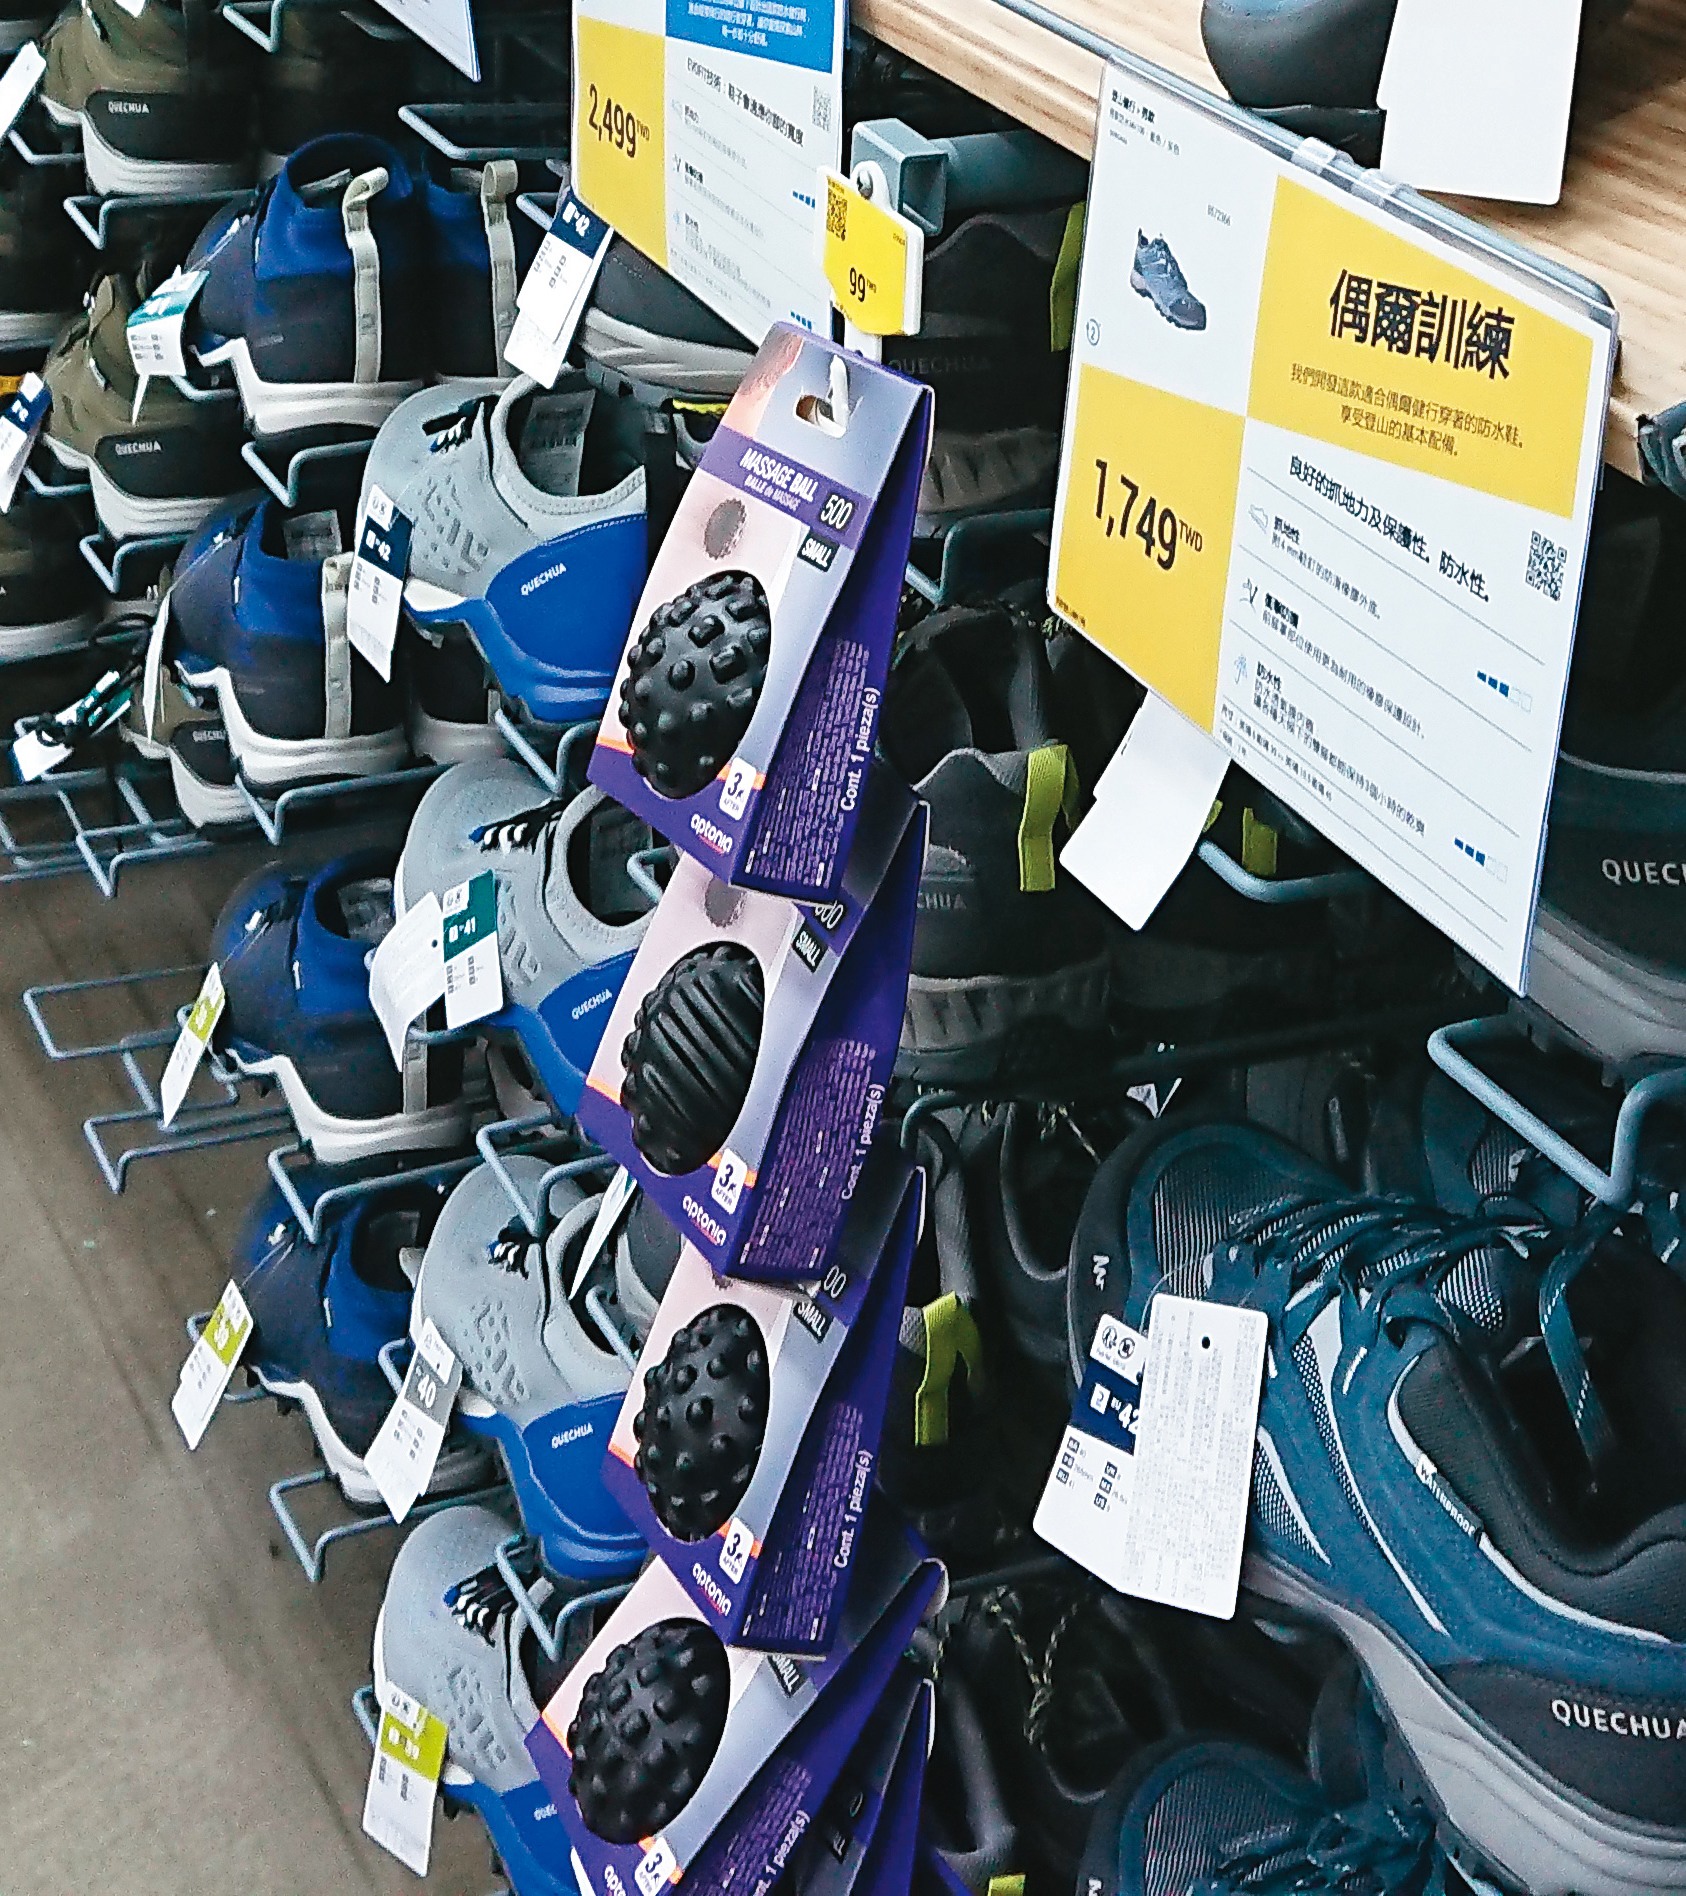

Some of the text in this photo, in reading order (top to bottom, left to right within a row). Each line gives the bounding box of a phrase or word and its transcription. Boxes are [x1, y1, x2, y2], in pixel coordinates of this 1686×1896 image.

[587, 83, 636, 159] 2,499
[849, 267, 866, 303] 99
[1329, 269, 1516, 381] 偶爾訓練
[739, 447, 819, 503] MASSAGE BALL
[820, 494, 854, 530] 500
[1095, 458, 1203, 571] 1,749 TWD
[801, 537, 833, 568] SMALL
[520, 562, 568, 597] QUECHUA
[856, 687, 882, 752] pieza(s)
[851, 753, 865, 762] 1
[690, 813, 733, 854] aptonia
[796, 930, 821, 967] SMALL
[571, 988, 613, 1020] QUECHUA
[858, 1083, 886, 1146] pieza(s)
[855, 1146, 868, 1156] 1
[718, 1163, 734, 1188] 3
[682, 1194, 728, 1247] aptonia
[797, 1300, 825, 1338] SMALL
[417, 1374, 437, 1409] 40
[551, 1422, 594, 1450] QUECHUA
[850, 1450, 874, 1514] pieza(s)
[845, 1514, 858, 1523] 1
[727, 1532, 742, 1556] 3
[692, 1562, 732, 1617] aptonia
